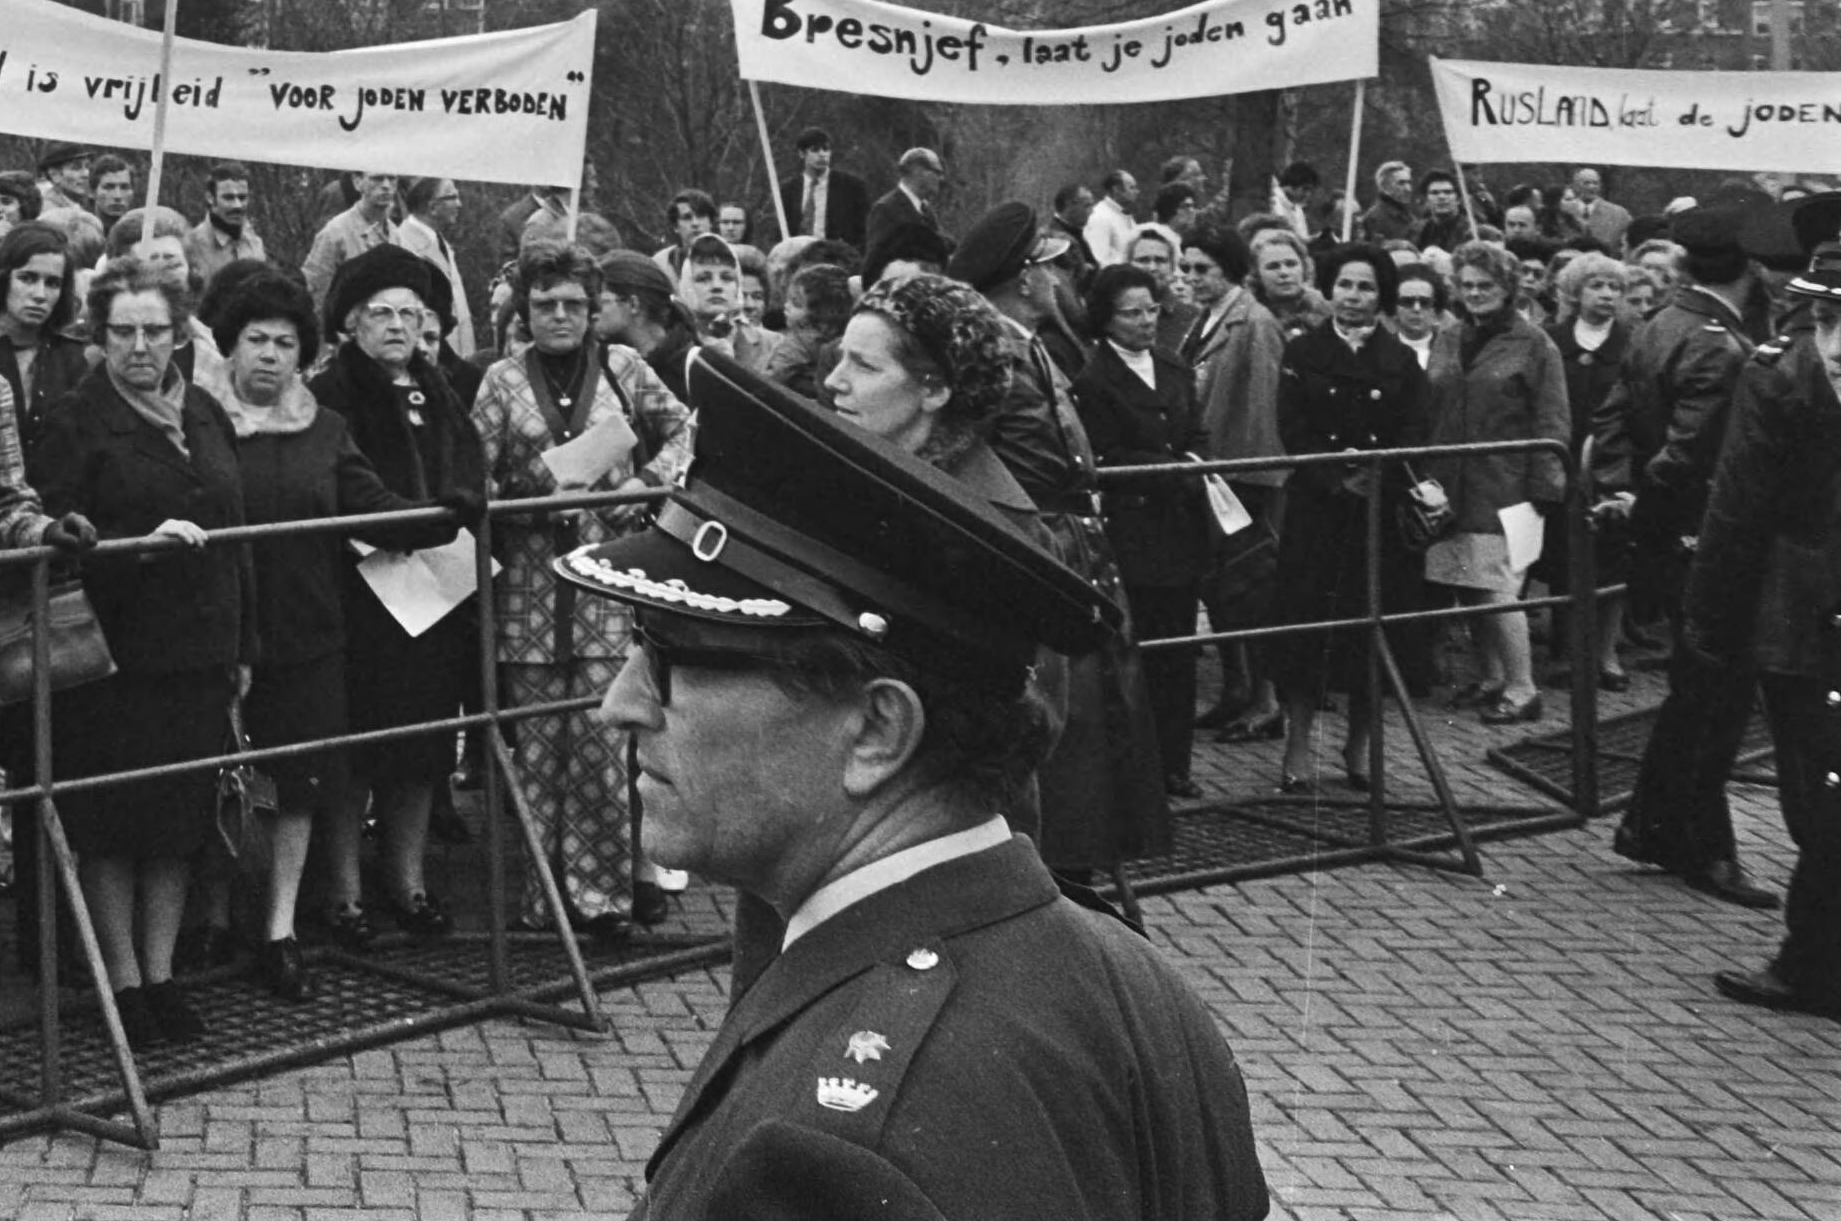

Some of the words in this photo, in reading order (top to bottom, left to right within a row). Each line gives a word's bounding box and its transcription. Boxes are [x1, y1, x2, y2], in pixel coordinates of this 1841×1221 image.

[1022, 36, 1091, 65] laat
[1101, 33, 1143, 73] je
[1150, 12, 1245, 69] joden
[27, 67, 57, 93] is
[1678, 103, 1714, 127] de
